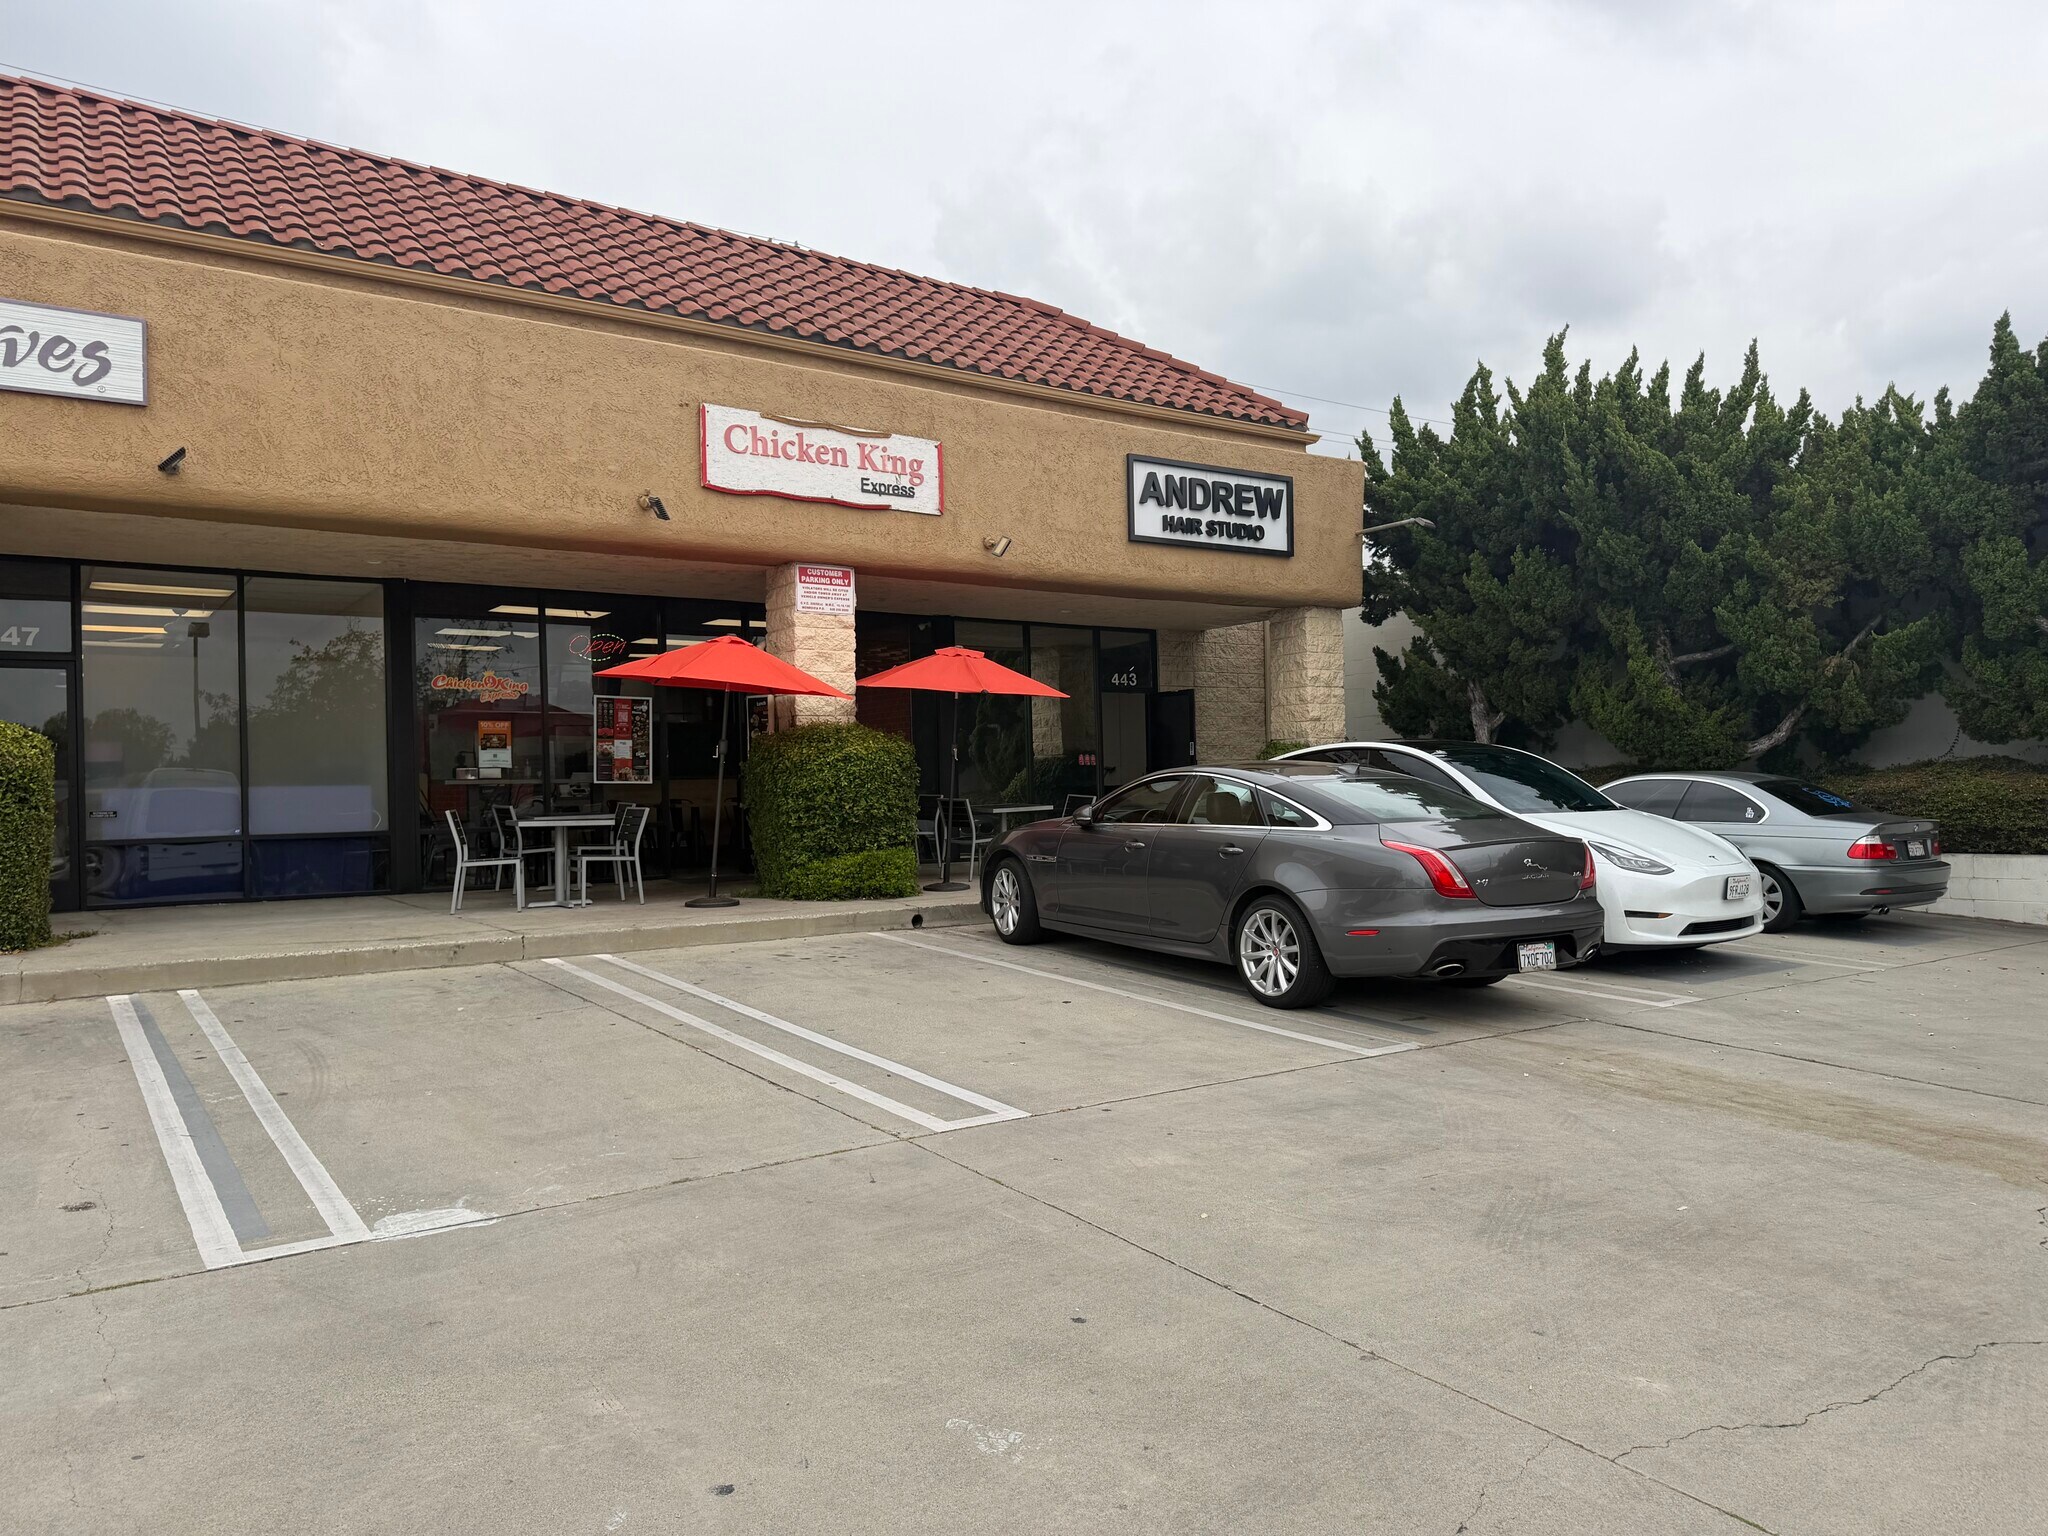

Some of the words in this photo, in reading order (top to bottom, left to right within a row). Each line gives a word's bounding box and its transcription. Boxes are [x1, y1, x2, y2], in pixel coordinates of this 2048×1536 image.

[0, 325, 112, 387] ves
[723, 423, 849, 468] Chicken
[856, 442, 925, 486] King
[860, 477, 915, 498] Express
[1139, 471, 1284, 520] ANDREW
[1162, 514, 1203, 535] HAIR
[1205, 520, 1265, 542] STUDIO
[801, 576, 830, 584] PARKING
[831, 578, 849, 586] ONLY
[807, 568, 843, 577] CUSTOMER
[0, 626, 40, 646] 47
[569, 634, 627, 657] Open
[431, 674, 485, 692] Chicken
[495, 677, 529, 694] King
[1111, 673, 1137, 686] 443
[480, 690, 520, 703] Express
